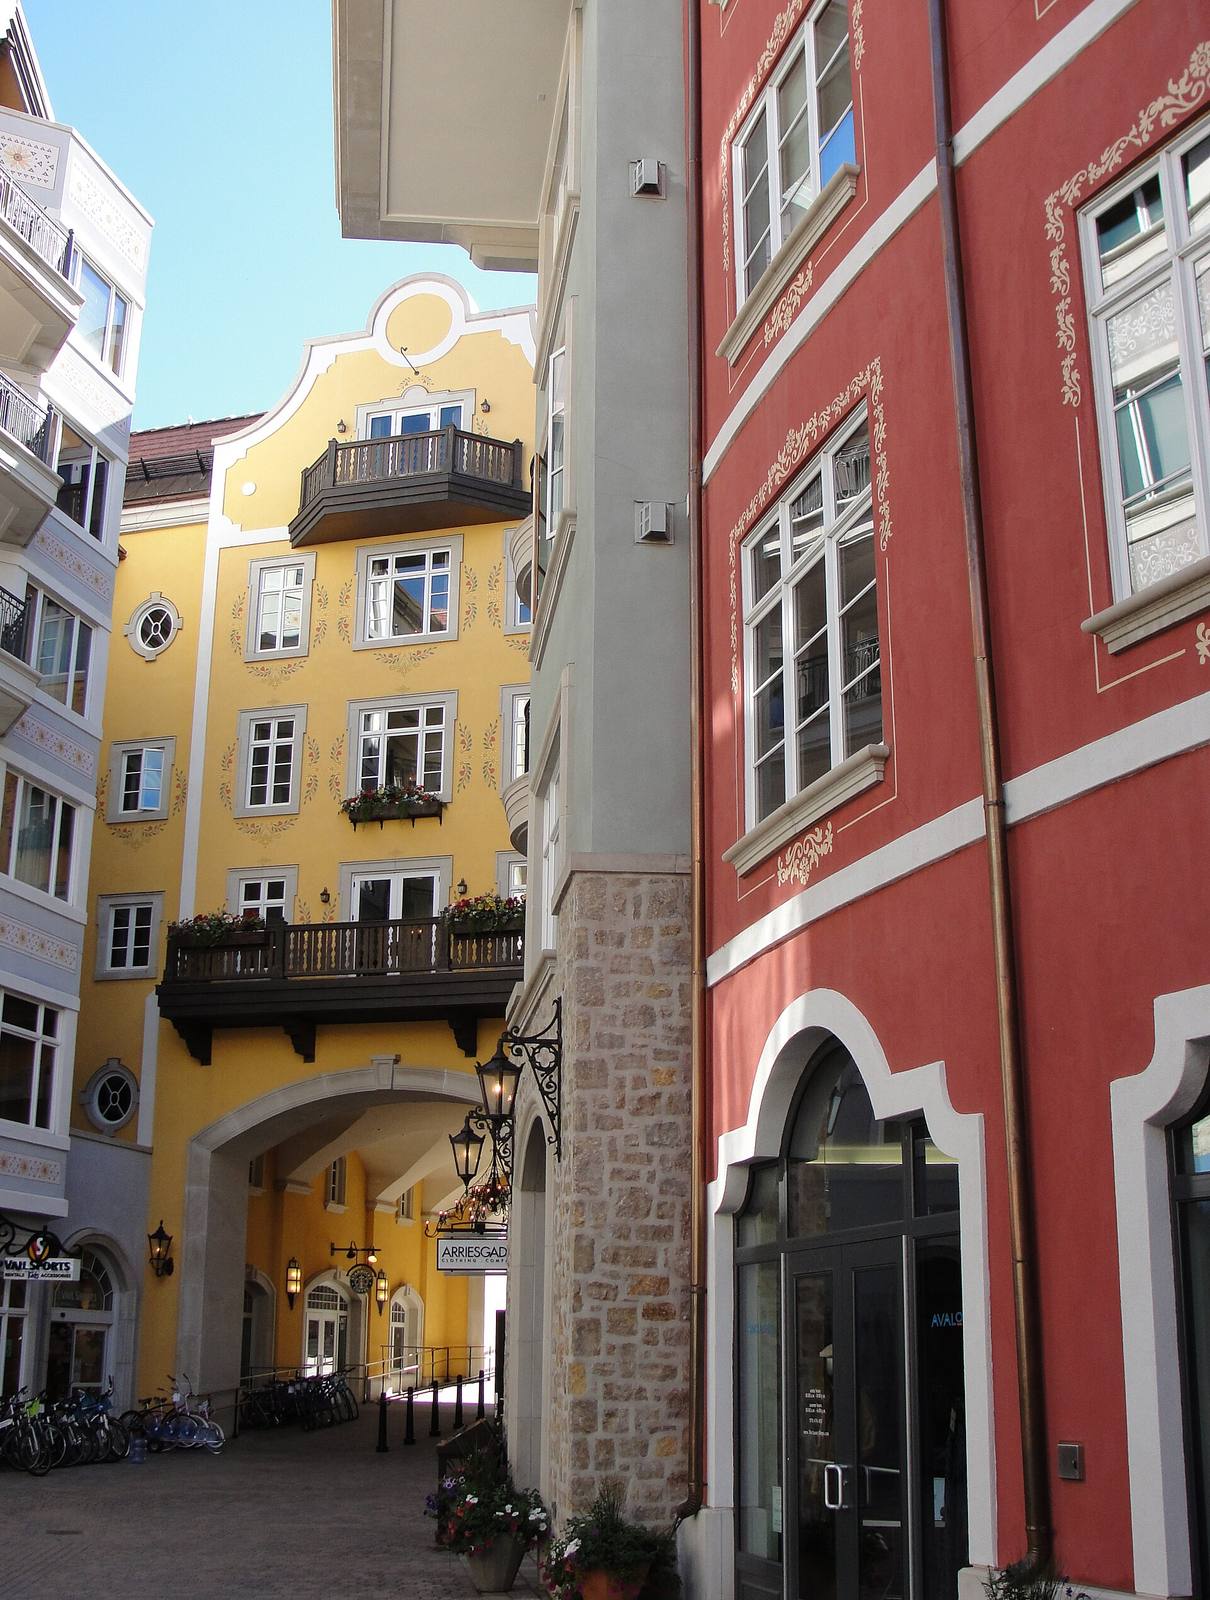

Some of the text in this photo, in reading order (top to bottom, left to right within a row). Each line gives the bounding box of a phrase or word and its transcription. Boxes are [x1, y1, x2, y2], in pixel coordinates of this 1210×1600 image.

[442, 1246, 508, 1258] ARRIESGAD
[4, 1260, 71, 1271] VAIL SPORTS
[930, 1311, 964, 1328] AVALO
